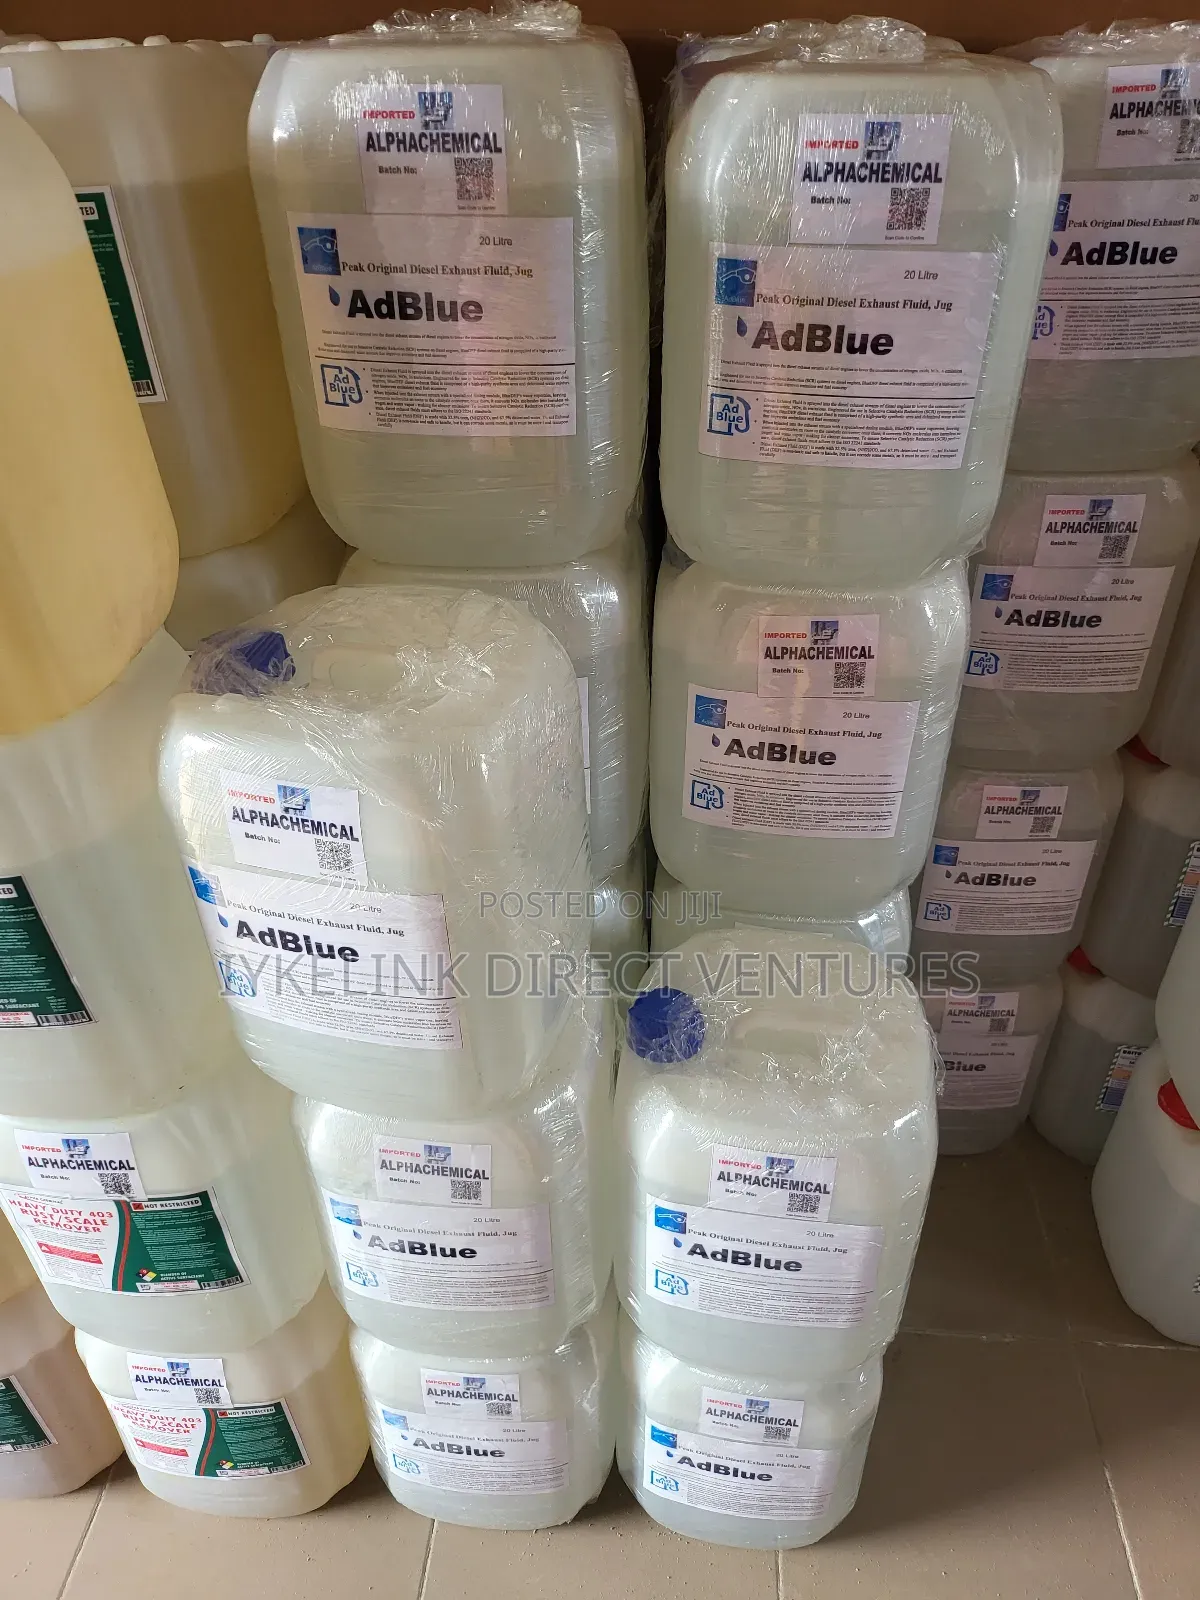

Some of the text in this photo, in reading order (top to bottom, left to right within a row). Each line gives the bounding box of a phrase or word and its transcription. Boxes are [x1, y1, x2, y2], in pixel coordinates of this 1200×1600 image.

[1112, 85, 1156, 93] IMPORTED
[363, 111, 415, 119] IMPORTED
[366, 132, 502, 153] ALPHACHEMICAL
[805, 140, 858, 149] IMPORTED
[379, 166, 401, 174] Batch
[802, 162, 942, 183] ALPHACHEMICAL
[811, 196, 834, 204] Batch
[1068, 220, 1087, 228] Peak
[1090, 219, 1124, 229] Original
[1127, 219, 1150, 227] Diesel
[479, 236, 512, 246] 20 Litre
[1061, 241, 1177, 265] AdBlue
[342, 262, 533, 278] Peak Original Diesel Exhaust Fluid, Jug
[904, 270, 938, 280] 20 Litre
[348, 290, 483, 322] AdBlue
[757, 294, 952, 312] Peak Original Diesel Exhaust Fluid, Jug
[751, 320, 894, 355] AdBlue
[334, 374, 349, 384] Ad
[329, 383, 355, 394] Blue
[722, 404, 738, 413] Ad
[716, 413, 743, 423] Blue
[1045, 521, 1138, 533] ALPHACHEMICAL
[1029, 594, 1057, 602] Original
[1005, 609, 1102, 628] AdBlue
[764, 646, 875, 659] ALPHACHEMICAL
[727, 721, 745, 729] Peak
[748, 723, 780, 733] Original
[783, 726, 806, 734] Diesel
[808, 728, 840, 736] Exhaust
[843, 730, 865, 738] Fluid,
[867, 731, 882, 739] Jug
[724, 738, 836, 765] AdBlue
[697, 793, 718, 803] Blue
[984, 806, 1062, 815] ALPHACHEMICAL
[232, 806, 359, 842] ALPHACHEMICAL
[245, 832, 280, 844] Batch No:
[955, 872, 1036, 886] AdBlue
[364, 903, 382, 913] Litre
[227, 901, 404, 937] Peak Original Diesel Exhaust Fluid, Jug
[237, 920, 359, 963] AdBlue
[947, 1009, 1015, 1017] ALPHACHEMICAL
[379, 1149, 421, 1157] IMPORTED
[28, 1157, 135, 1170] ALPHACHEMICAL
[380, 1160, 489, 1180] ALPHACHEMICAL
[719, 1159, 761, 1169] IMPORTED
[717, 1171, 830, 1194] ALPHACHEMICAL
[9, 1199, 46, 1211] HEAVY
[51, 1207, 82, 1216] DUTY
[160, 1200, 199, 1208] RESTRICTED
[20, 1208, 108, 1226] RUST/SCALE
[33, 1218, 101, 1232] REMOVER
[363, 1221, 381, 1229] Peak
[383, 1225, 415, 1233] Original
[688, 1229, 707, 1237] Peak
[710, 1233, 743, 1243] Original
[746, 1238, 769, 1247] Diesel
[772, 1242, 805, 1250] Exhaust
[368, 1235, 477, 1258] AdBlue
[687, 1243, 802, 1271] AdBlue
[661, 1280, 683, 1290] Blue
[136, 1375, 224, 1387] ALPHACHEMICAL
[427, 1388, 518, 1402] ALPHACHEMICAL
[707, 1399, 742, 1408] IMPORTED
[706, 1407, 799, 1427] ALPHACHEMICAL
[413, 1438, 506, 1457] AdBlue
[678, 1456, 772, 1481] AdBlue
